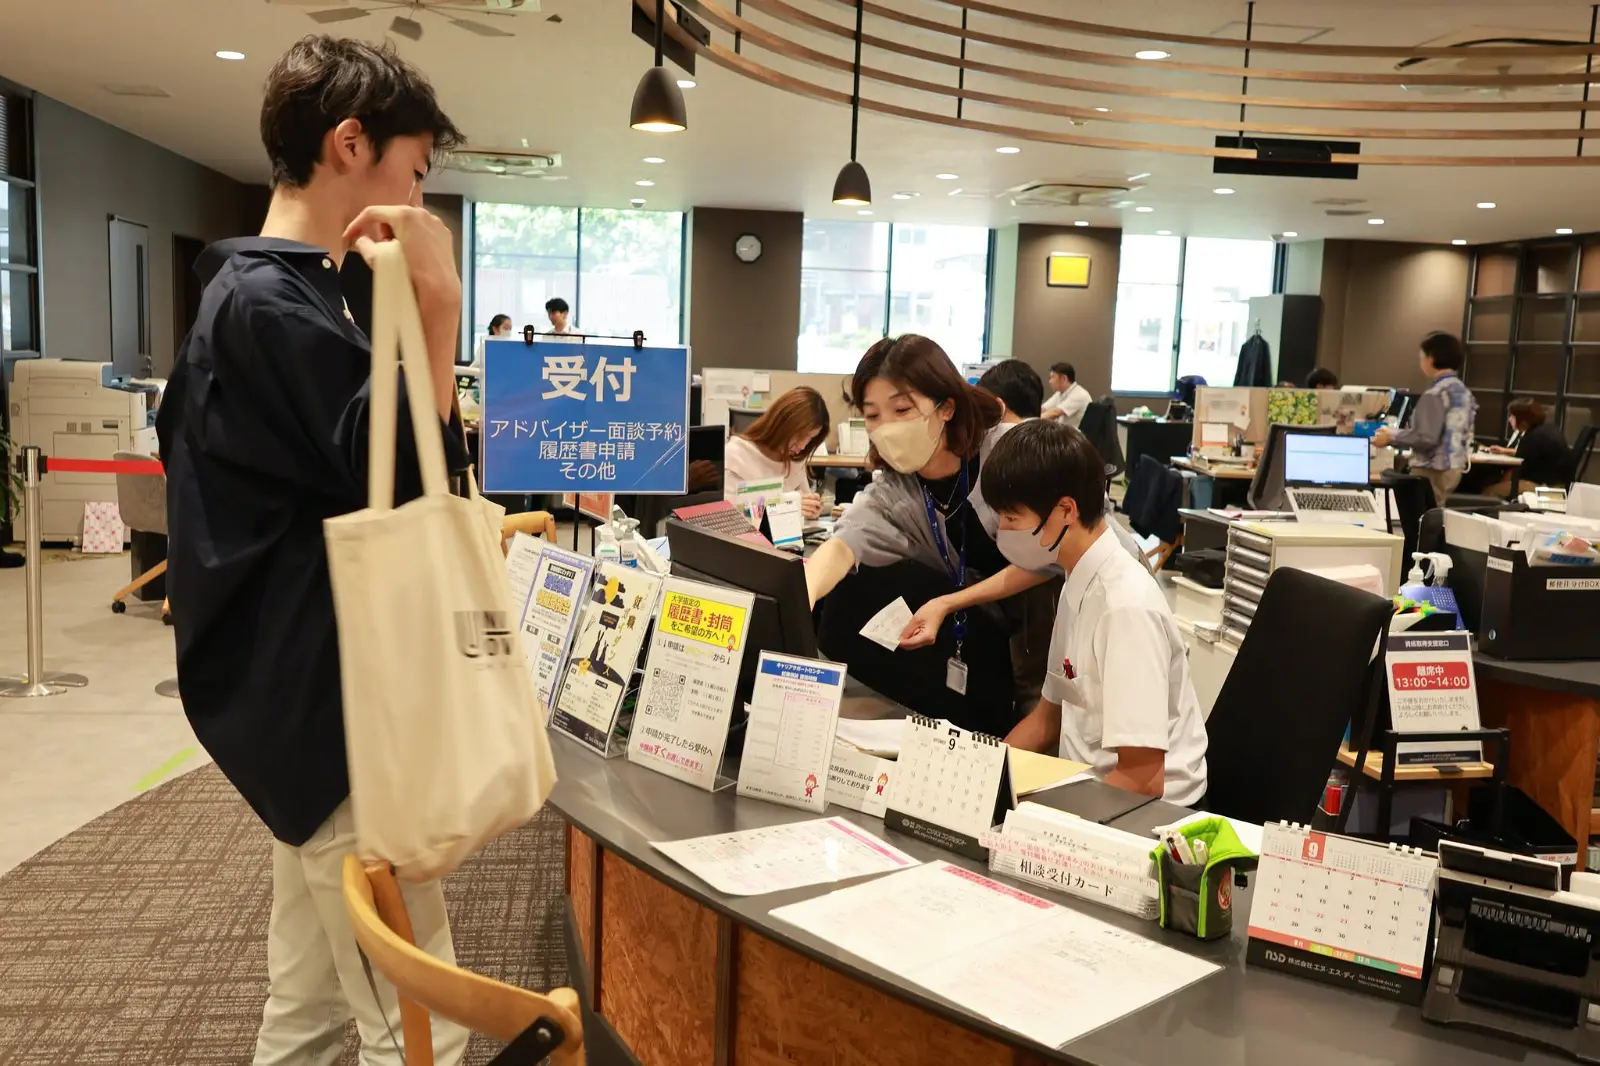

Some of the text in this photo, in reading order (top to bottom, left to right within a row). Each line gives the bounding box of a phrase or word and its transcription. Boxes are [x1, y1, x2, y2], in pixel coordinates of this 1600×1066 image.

[541, 355, 637, 402] 受付
[490, 419, 682, 441] アドバイザー面談予約
[538, 441, 635, 461] 履歴書申請
[559, 461, 616, 481] その他
[671, 594, 700, 607] 大学指定の
[668, 603, 734, 633] 履歴書・封筒
[1416, 665, 1444, 676] 離席中
[948, 738, 956, 750] 9
[1308, 841, 1320, 858] 9
[1019, 858, 1114, 897] 相談受付カード
